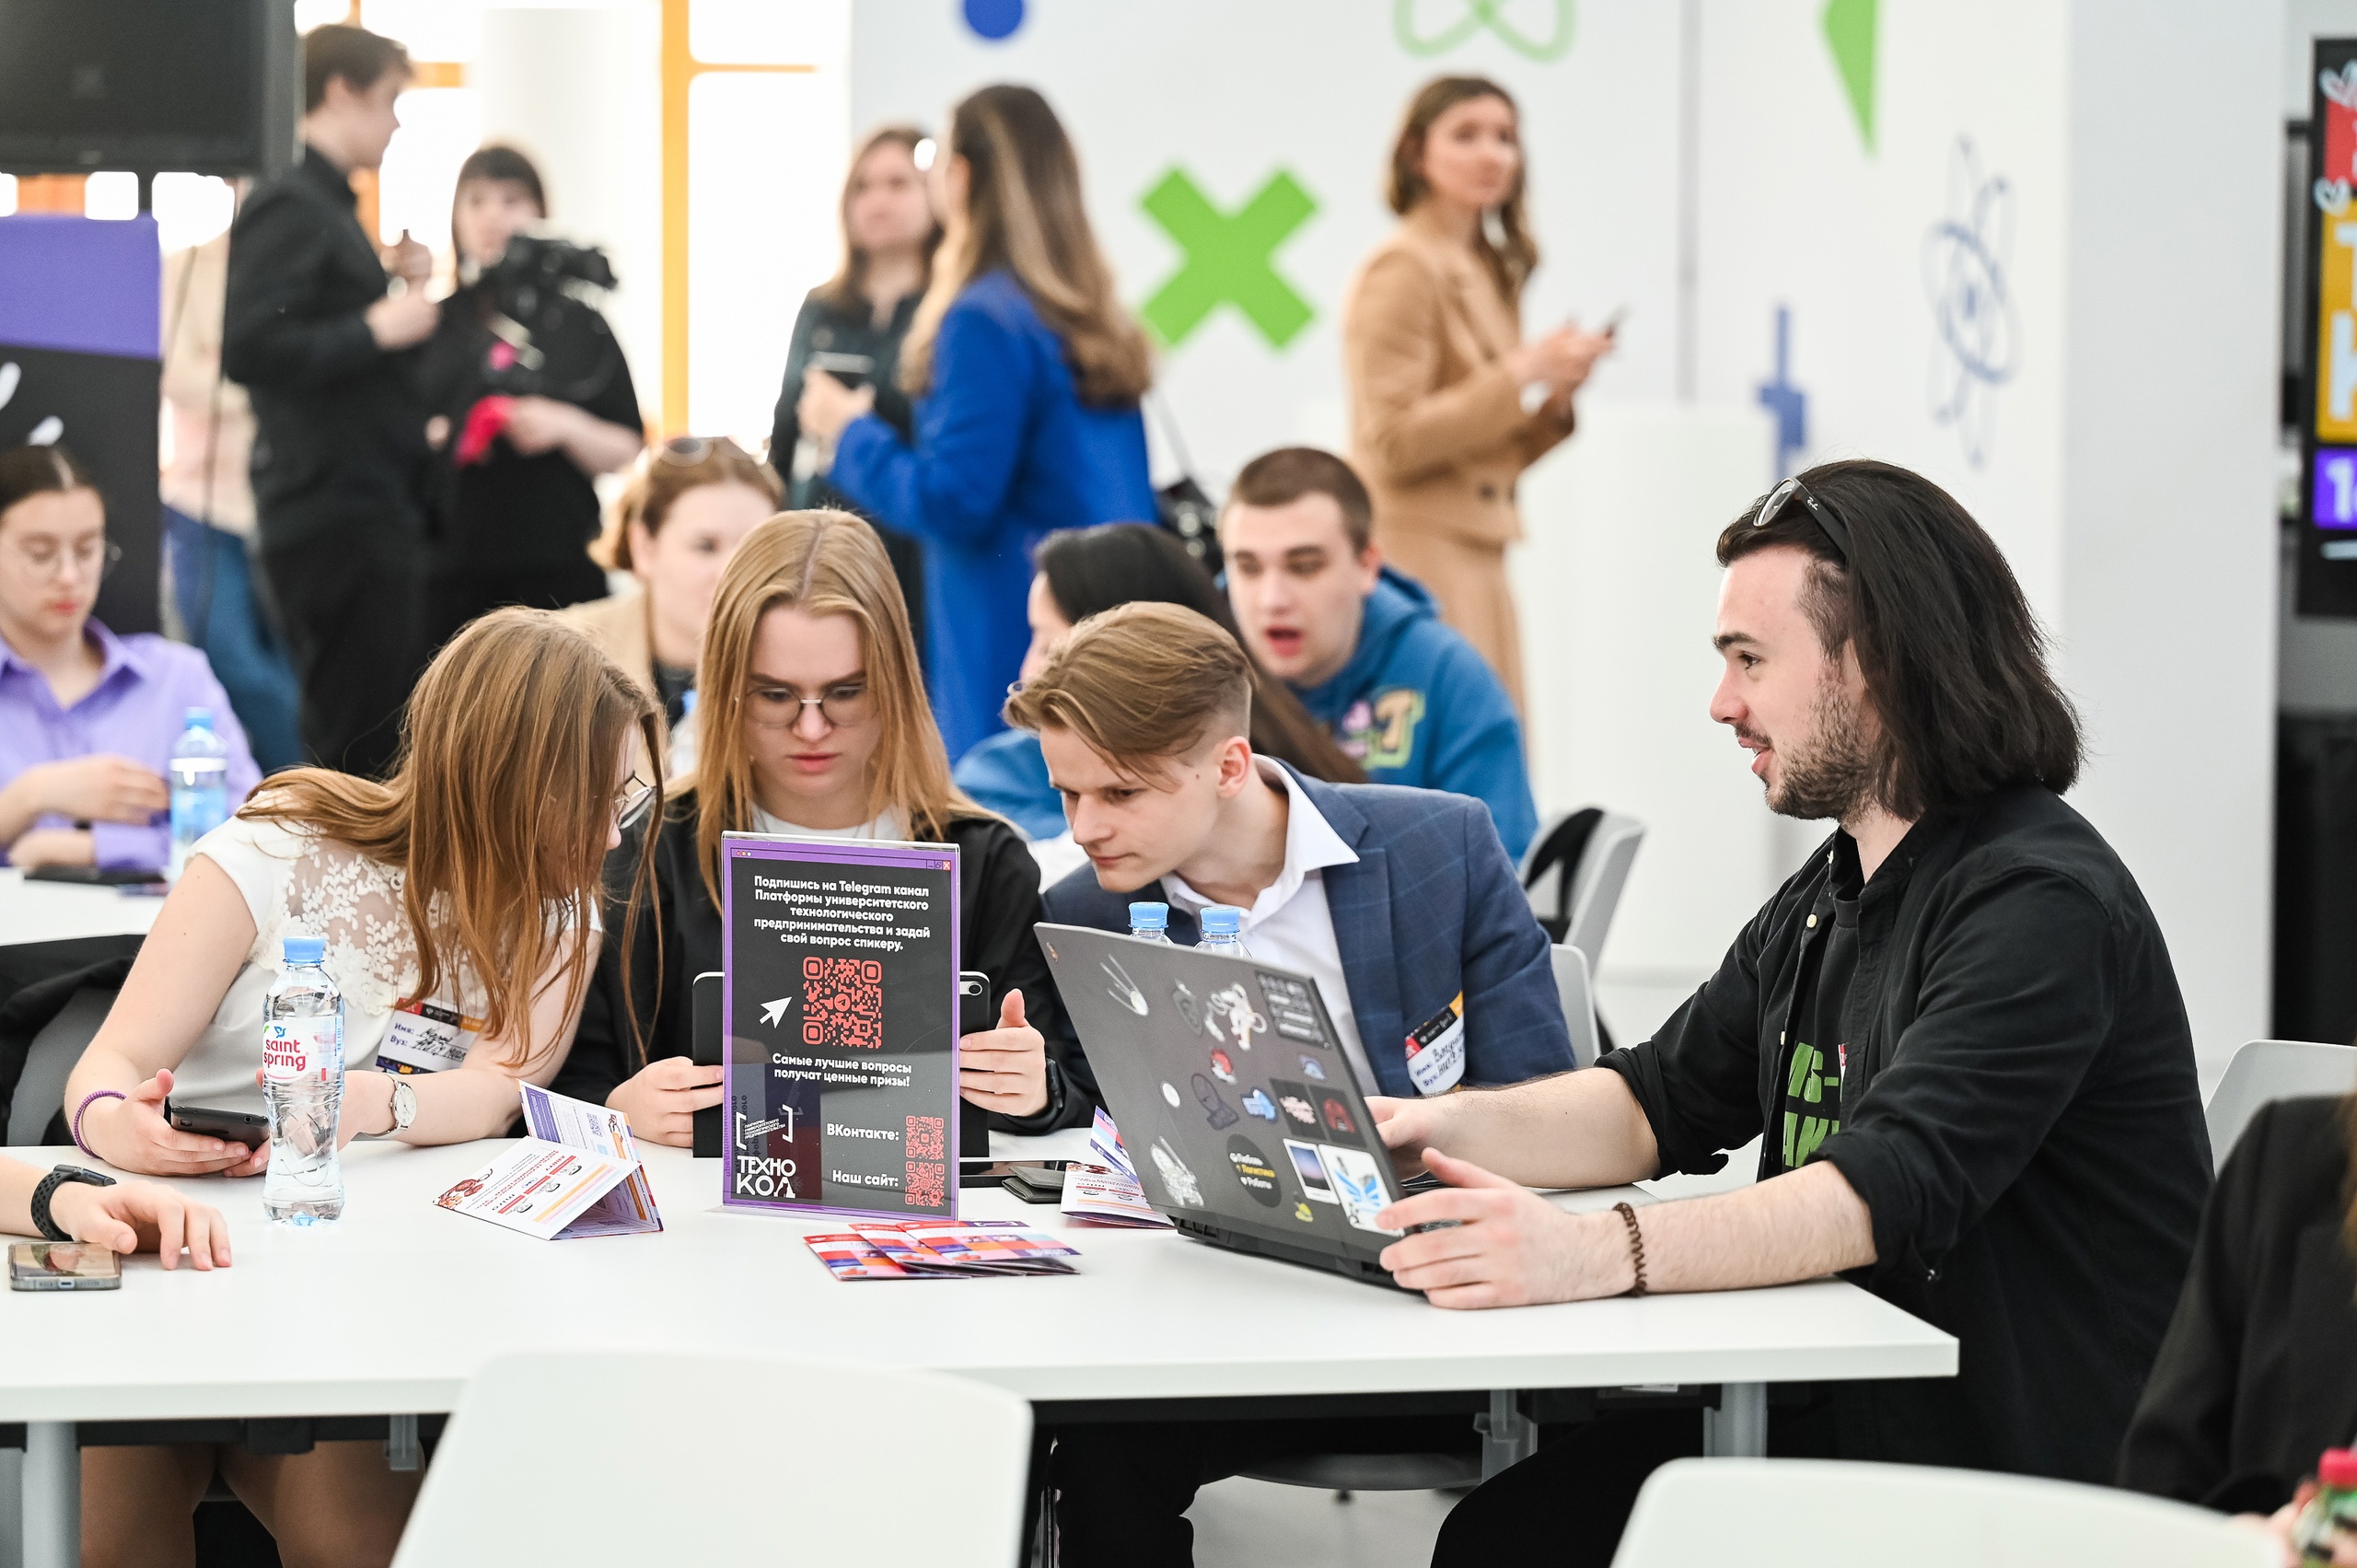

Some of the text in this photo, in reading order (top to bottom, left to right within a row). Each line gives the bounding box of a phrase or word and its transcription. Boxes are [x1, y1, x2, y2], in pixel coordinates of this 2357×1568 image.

[755, 876, 929, 897] Подпишись на Telegram канал
[756, 889, 928, 910] Платформы университетского
[790, 908, 893, 922] технологического
[754, 919, 930, 938] предпринимательства и задай
[781, 933, 903, 952] свой вопрос спикеру.
[265, 1039, 300, 1053] saint
[263, 1051, 306, 1072] spring
[772, 1053, 912, 1074] Самые лучшие вопросы
[774, 1069, 911, 1088] получат ценные призы!
[827, 1123, 900, 1141] ВКонтакте:
[737, 1156, 796, 1177] ТЕХНО
[832, 1169, 899, 1187] Наш сайт:
[492, 1193, 516, 1211] miro
